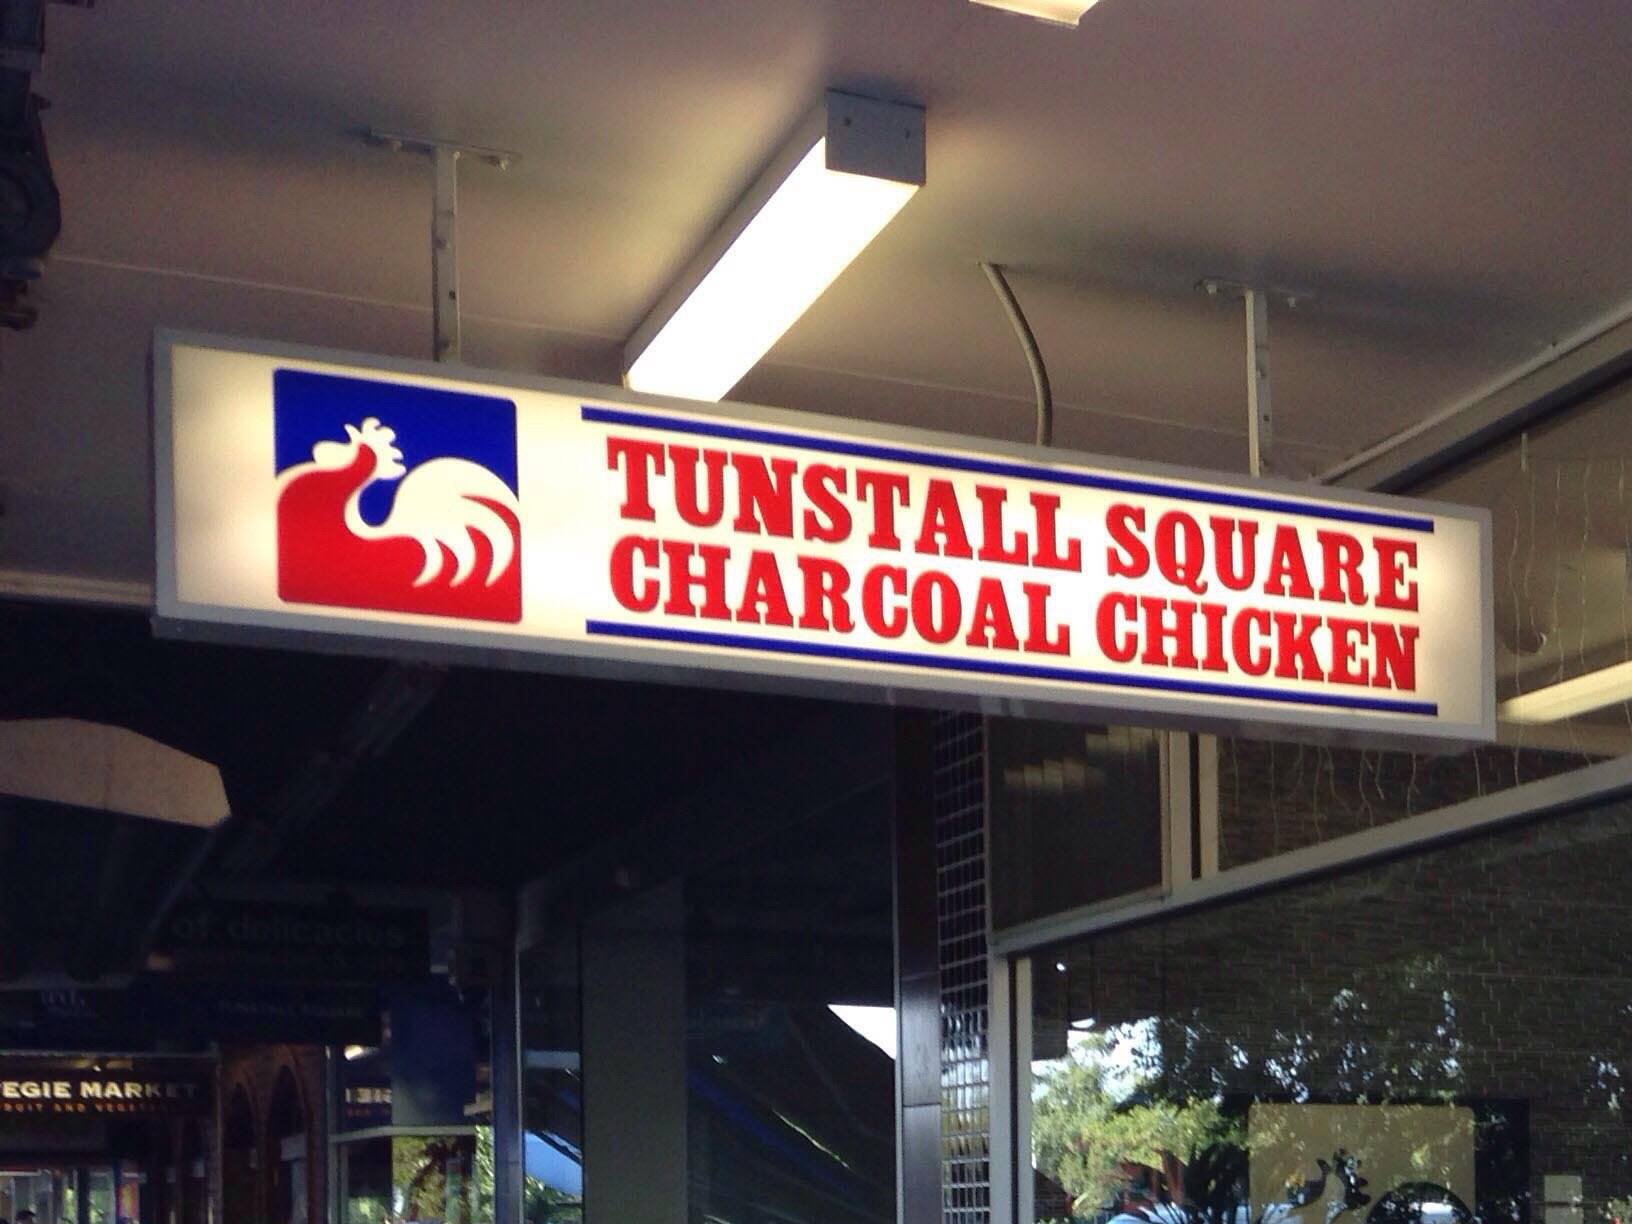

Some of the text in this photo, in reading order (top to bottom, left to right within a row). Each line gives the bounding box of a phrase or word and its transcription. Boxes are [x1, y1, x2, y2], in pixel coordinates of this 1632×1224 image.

[607, 436, 1419, 613] TUNSTALL SQUARE
[609, 535, 1420, 691] CHARCOAL CHICKEN
[0, 1080, 72, 1099] EGIE
